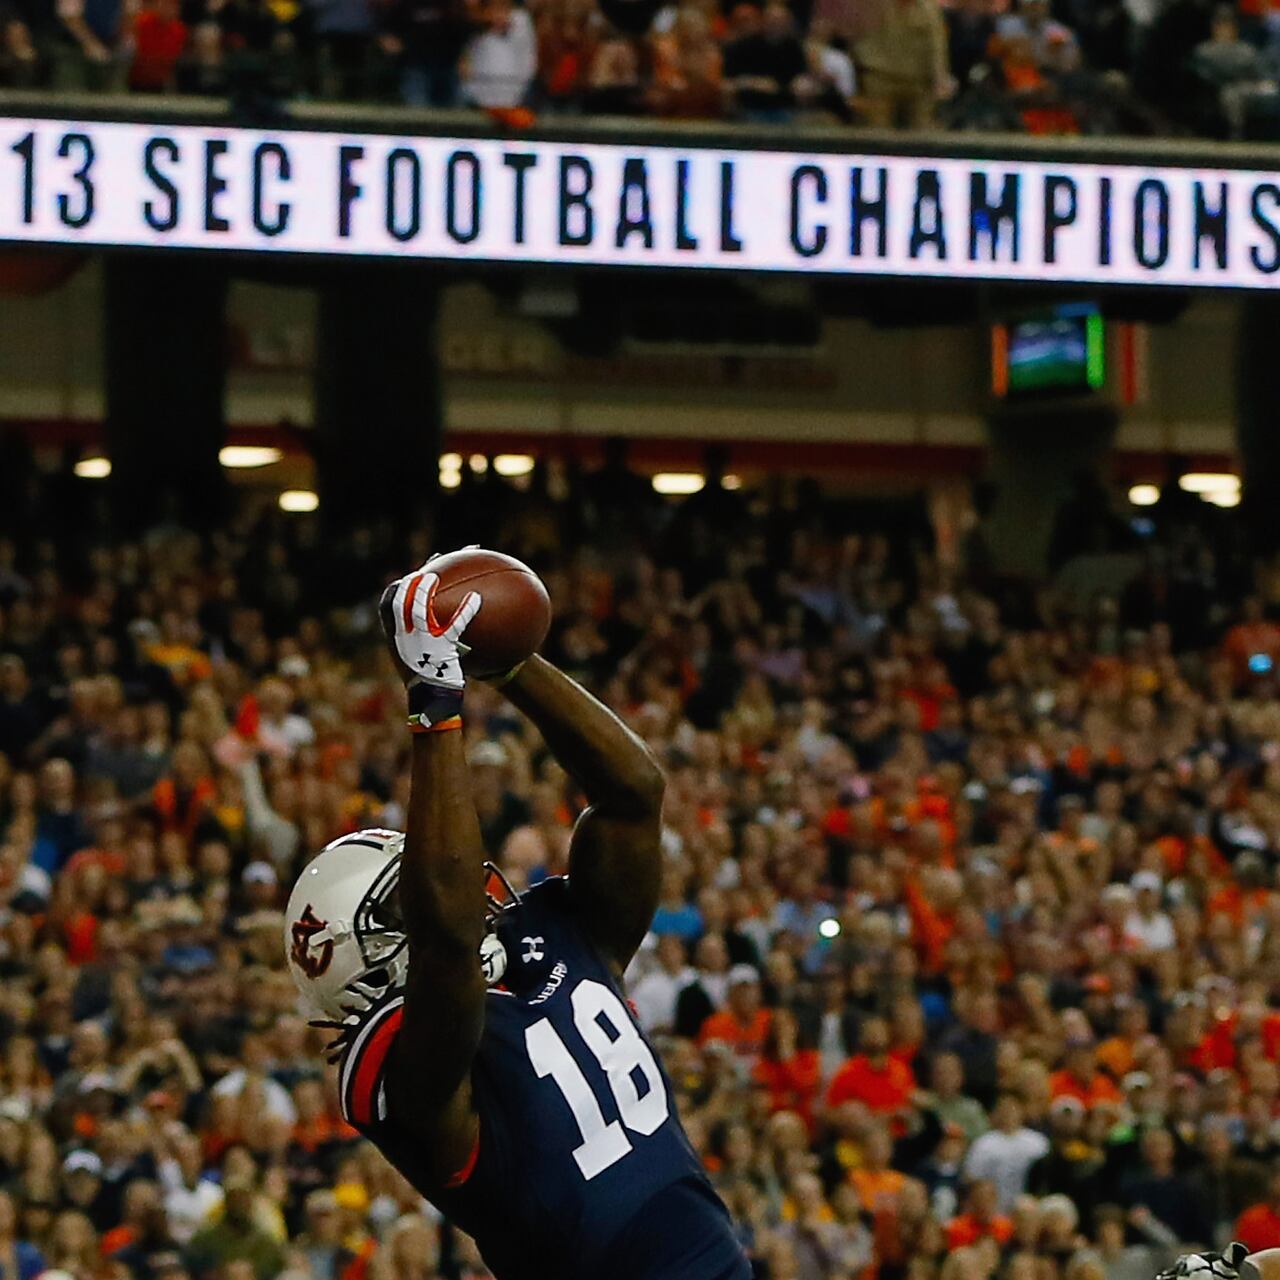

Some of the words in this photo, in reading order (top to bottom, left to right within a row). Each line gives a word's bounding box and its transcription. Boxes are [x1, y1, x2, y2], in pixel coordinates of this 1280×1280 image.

[144, 137, 292, 237] SEC
[338, 145, 743, 252] FOOTBALL
[524, 978, 670, 1181] 18
